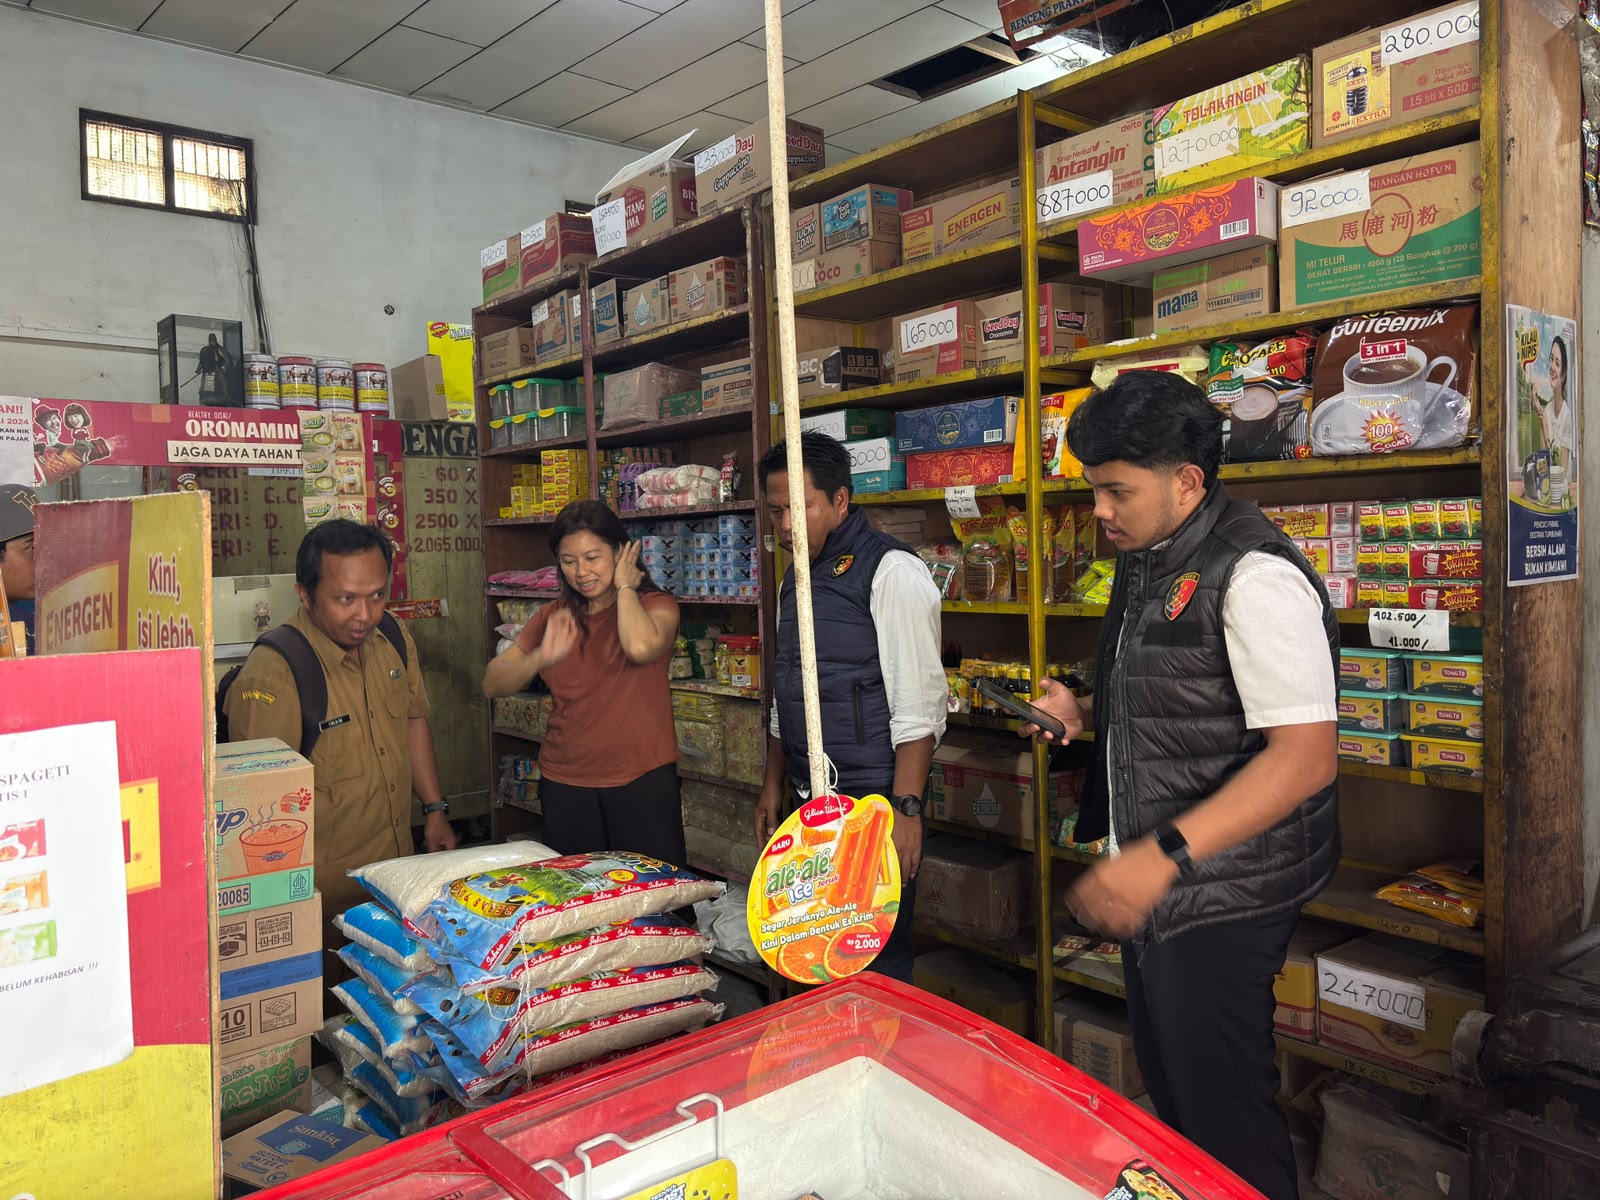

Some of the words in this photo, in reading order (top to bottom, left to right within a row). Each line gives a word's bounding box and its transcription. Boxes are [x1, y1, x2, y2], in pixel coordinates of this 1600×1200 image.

[1409, 95, 1422, 107] 15
[1447, 83, 1469, 98] 500
[1356, 109, 1387, 124] EXTRA
[786, 135, 802, 147] ood
[786, 155, 817, 165] appuccino
[1046, 146, 1127, 183] Antangin
[1415, 163, 1452, 180] HOFUN
[947, 201, 1002, 237] ENERGEN
[795, 220, 817, 240] LUCKY
[800, 234, 814, 250] DAY
[1307, 268, 1332, 279] BERAT
[1333, 264, 1361, 274] BERSIH
[1367, 259, 1385, 268] 4000
[1406, 249, 1441, 263] Bungkus
[1452, 243, 1468, 252] 200
[1319, 255, 1345, 266] TELUR
[1157, 290, 1199, 319] mama
[1521, 330, 1537, 346] KILAU
[1365, 345, 1374, 355] 3
[1376, 343, 1389, 354] in
[1395, 342, 1401, 352] 1
[1521, 344, 1537, 359] NIPIS
[188, 410, 212, 420] HEALTHY
[185, 420, 299, 440] ORONAMIN
[1369, 423, 1393, 438] 100
[1371, 433, 1412, 454] Sachet
[173, 446, 210, 459] JAGA
[214, 447, 250, 460] DAYA
[253, 448, 293, 460] TAHAN
[436, 467, 459, 482] 60
[210, 487, 239, 505] ERI
[424, 489, 457, 504] 350
[416, 514, 458, 529] 2500
[212, 538, 242, 557] ERI
[1526, 545, 1546, 558] BERSIH
[1548, 543, 1566, 556] ALAMI
[1446, 558, 1474, 570] GRATIS
[1525, 562, 1543, 575] BUKAN
[1544, 560, 1567, 573] KIMIAWI
[149, 554, 181, 602] Kini,
[46, 591, 113, 650] ENERGEN
[138, 611, 153, 648] isi
[157, 613, 195, 648] lebih
[1443, 669, 1457, 677] TONG
[1441, 752, 1456, 760] TONG
[771, 839, 791, 852] BARU
[817, 873, 840, 888] Jeruk
[761, 920, 786, 933] Segar
[787, 912, 826, 927] Jeruknya
[827, 902, 858, 917] Ale-Ale
[761, 939, 779, 950] Kini
[780, 932, 808, 945] Dalam
[810, 921, 840, 936] Bentuk
[842, 918, 852, 927] Es
[854, 912, 874, 924] Krim
[34, 965, 84, 985] KEHABISAN
[1324, 972, 1424, 1019] 247000
[233, 1064, 255, 1080] Suka
[289, 1125, 342, 1146] Sunkist
